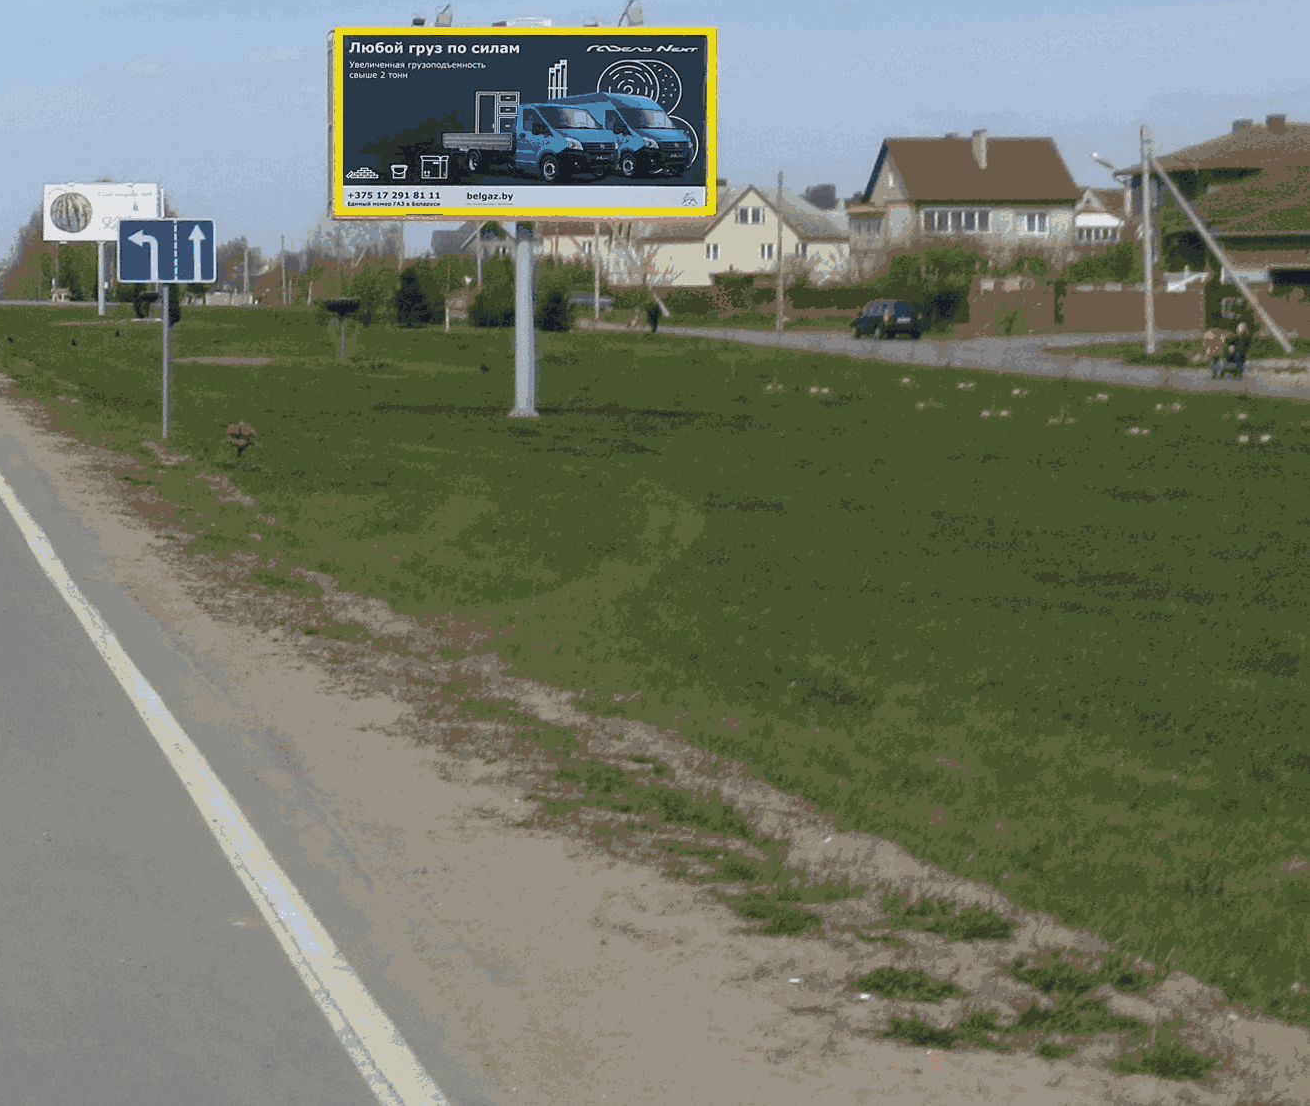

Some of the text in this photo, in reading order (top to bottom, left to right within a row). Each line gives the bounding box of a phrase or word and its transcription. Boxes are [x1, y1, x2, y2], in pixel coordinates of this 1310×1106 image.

[348, 41, 520, 56] Любой груз по силам
[349, 61, 486, 70] Увеличенная грузоподъемность
[380, 71, 386, 79] 2
[347, 191, 441, 199] +375 17 291 81 11
[466, 192, 514, 201] belgaz.by
